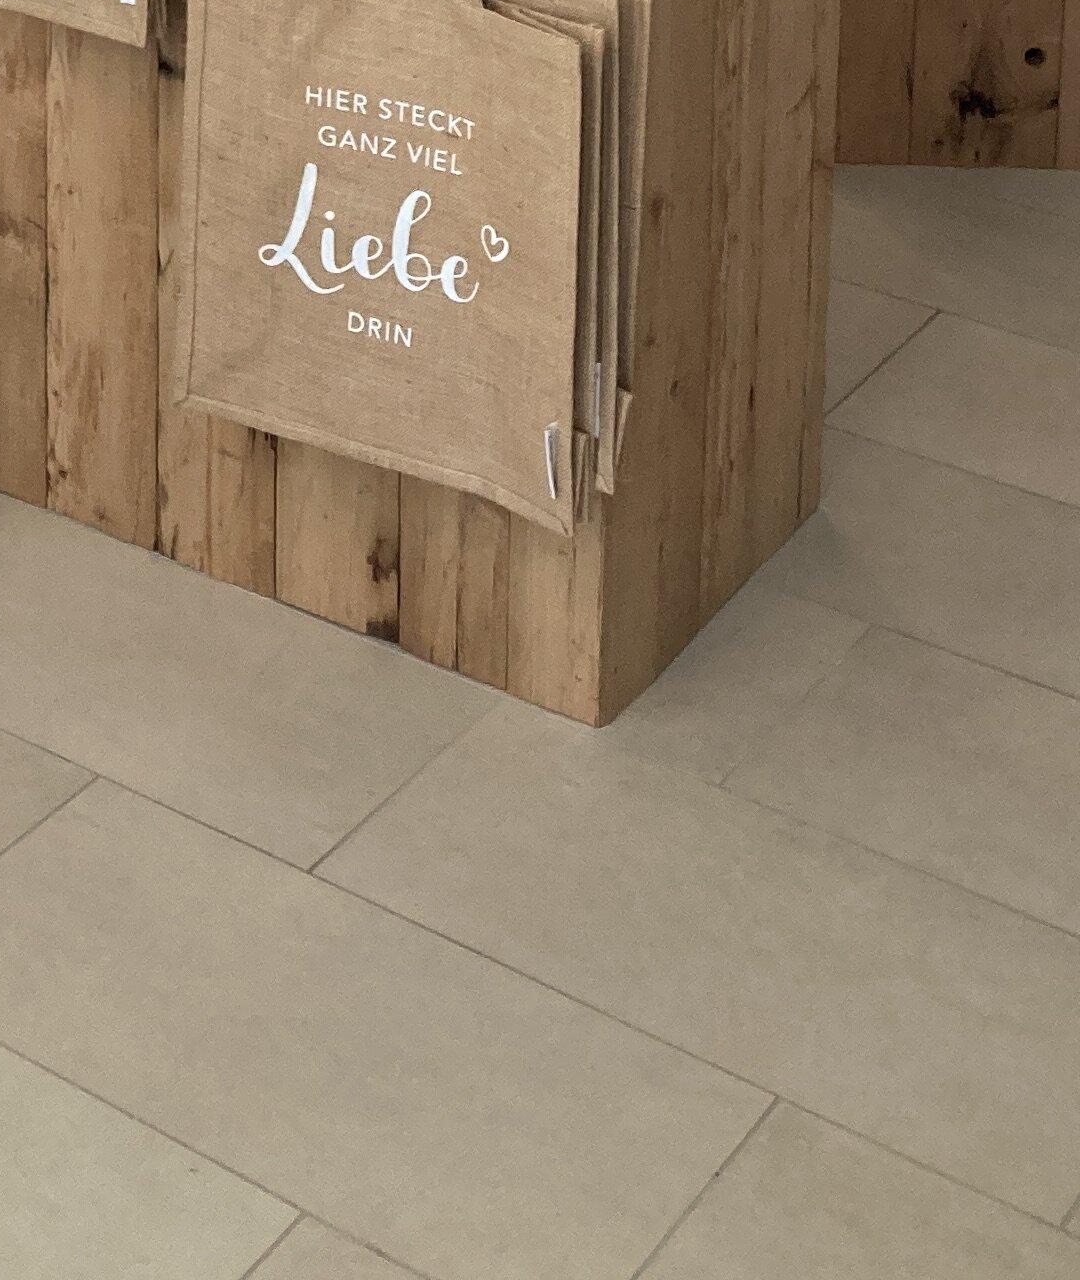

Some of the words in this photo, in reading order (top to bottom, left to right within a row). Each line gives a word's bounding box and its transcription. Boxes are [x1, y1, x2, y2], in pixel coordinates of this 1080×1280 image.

[305, 85, 368, 115] HIER
[378, 98, 476, 140] STECKT
[318, 125, 397, 160] GANZ
[406, 141, 463, 176] VIEL
[258, 162, 480, 303] Liebe
[347, 311, 413, 348] DRIN
